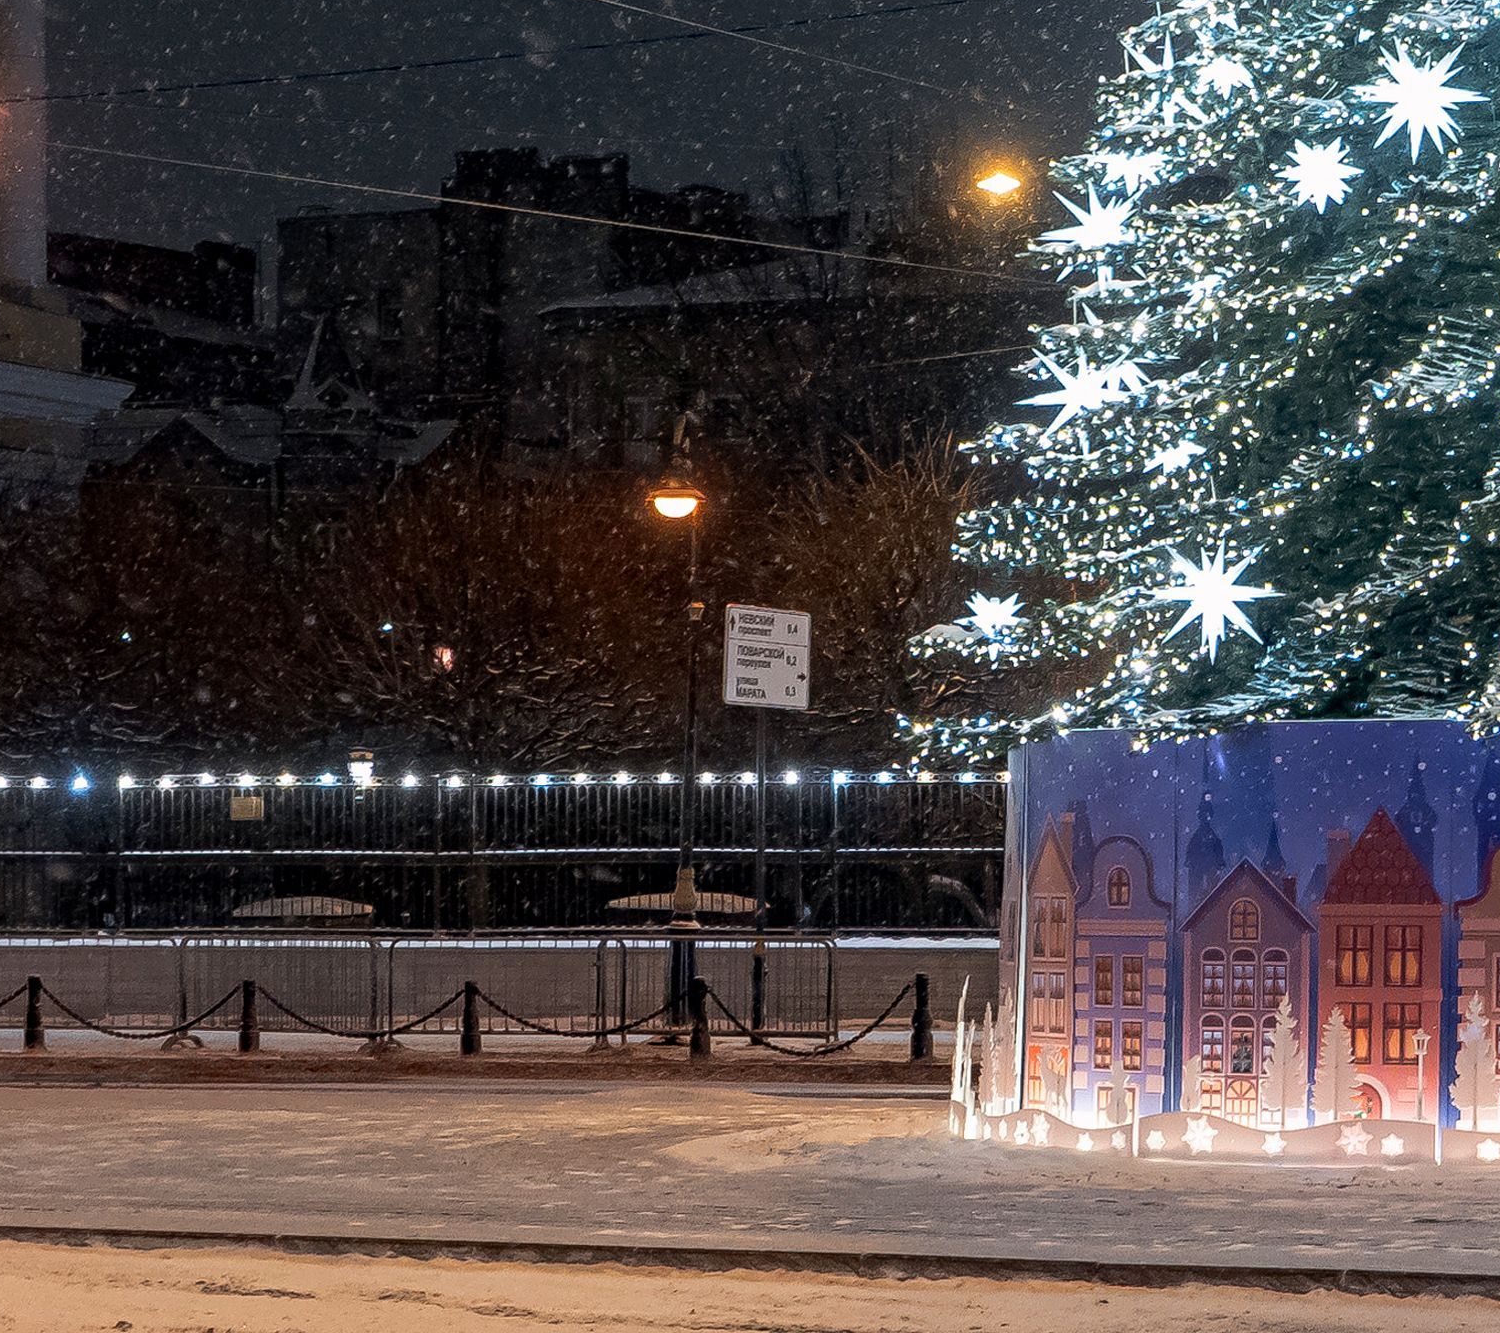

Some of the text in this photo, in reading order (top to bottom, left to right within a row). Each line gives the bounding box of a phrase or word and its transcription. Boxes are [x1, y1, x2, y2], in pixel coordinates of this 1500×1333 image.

[738, 613, 775, 626] НЕВСКИЙ
[737, 626, 773, 637] проспект
[737, 645, 785, 660] ПОВАРСКОЙ
[735, 687, 767, 699] МАРАТА
